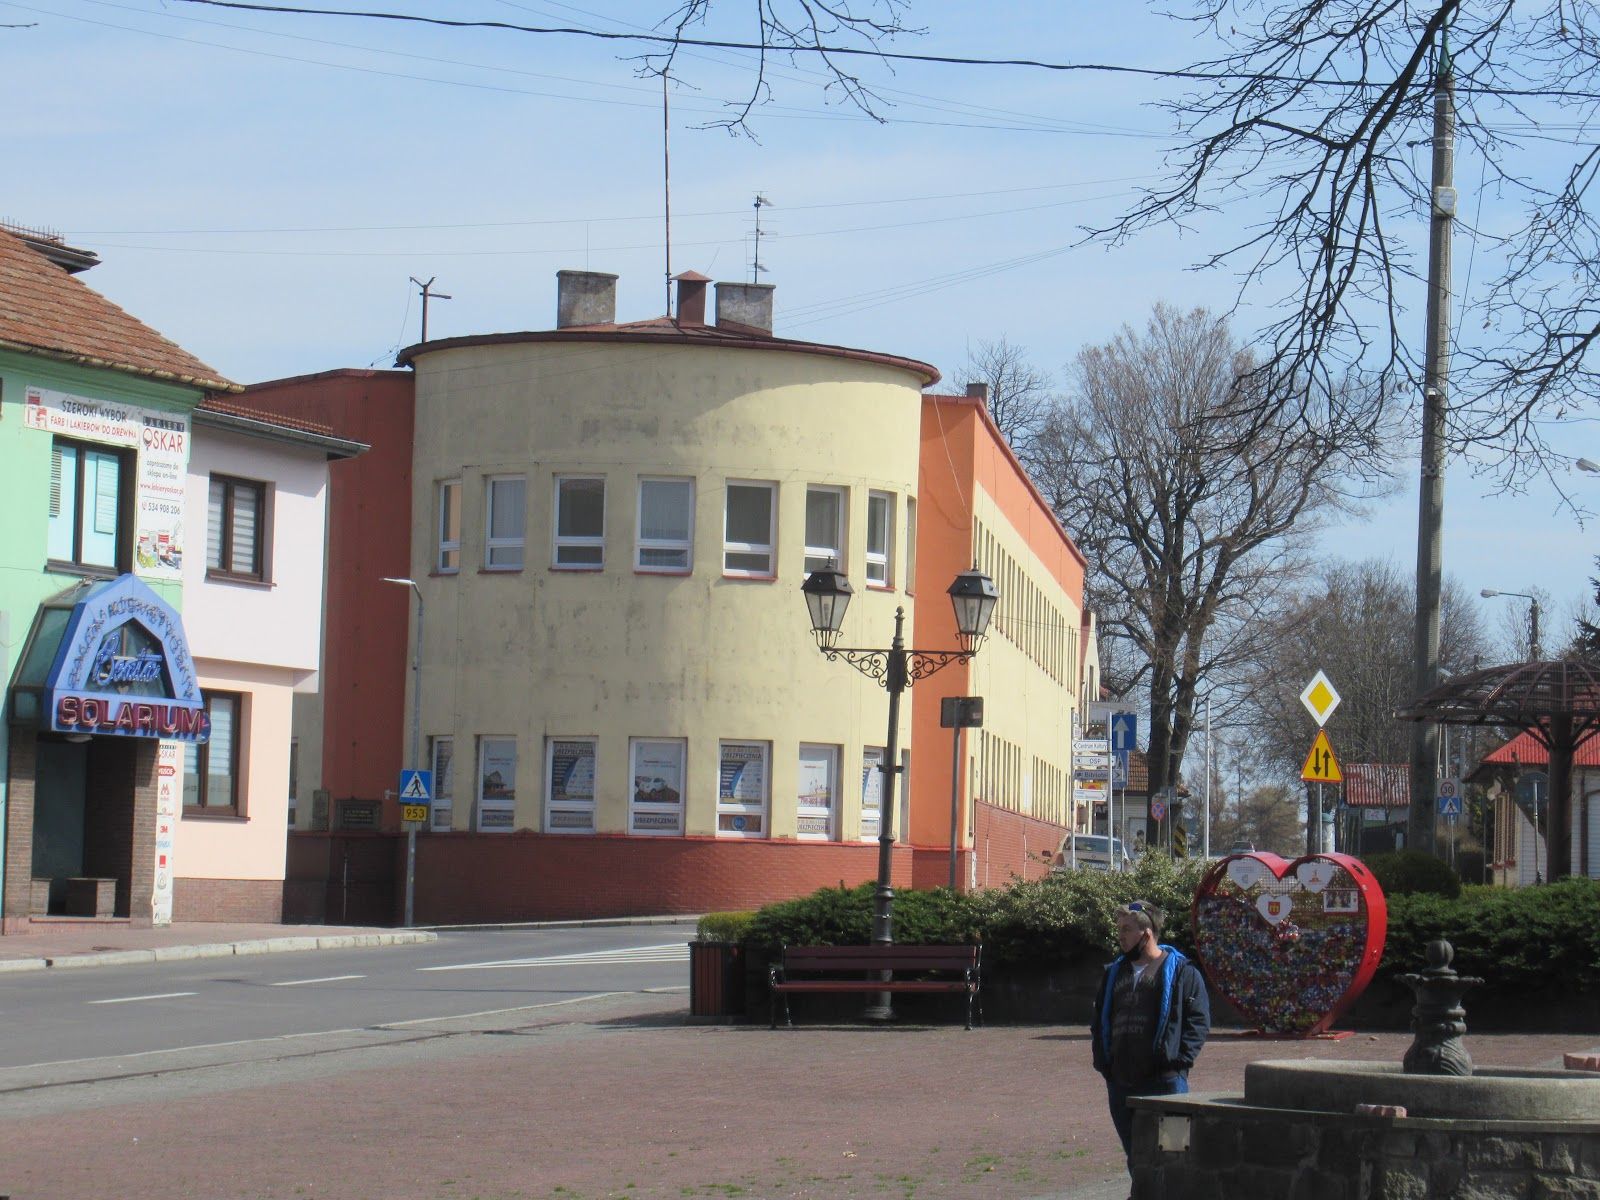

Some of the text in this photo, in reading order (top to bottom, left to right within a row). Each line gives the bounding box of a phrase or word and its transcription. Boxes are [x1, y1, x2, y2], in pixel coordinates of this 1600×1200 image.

[62, 400, 98, 417] SZEROKI
[50, 416, 65, 427] FARB
[102, 425, 110, 435] DO
[142, 427, 183, 453] OSKAR
[148, 502, 181, 515] 534 908 206
[58, 695, 203, 735] SOLARIUM
[405, 808, 426, 820] 953
